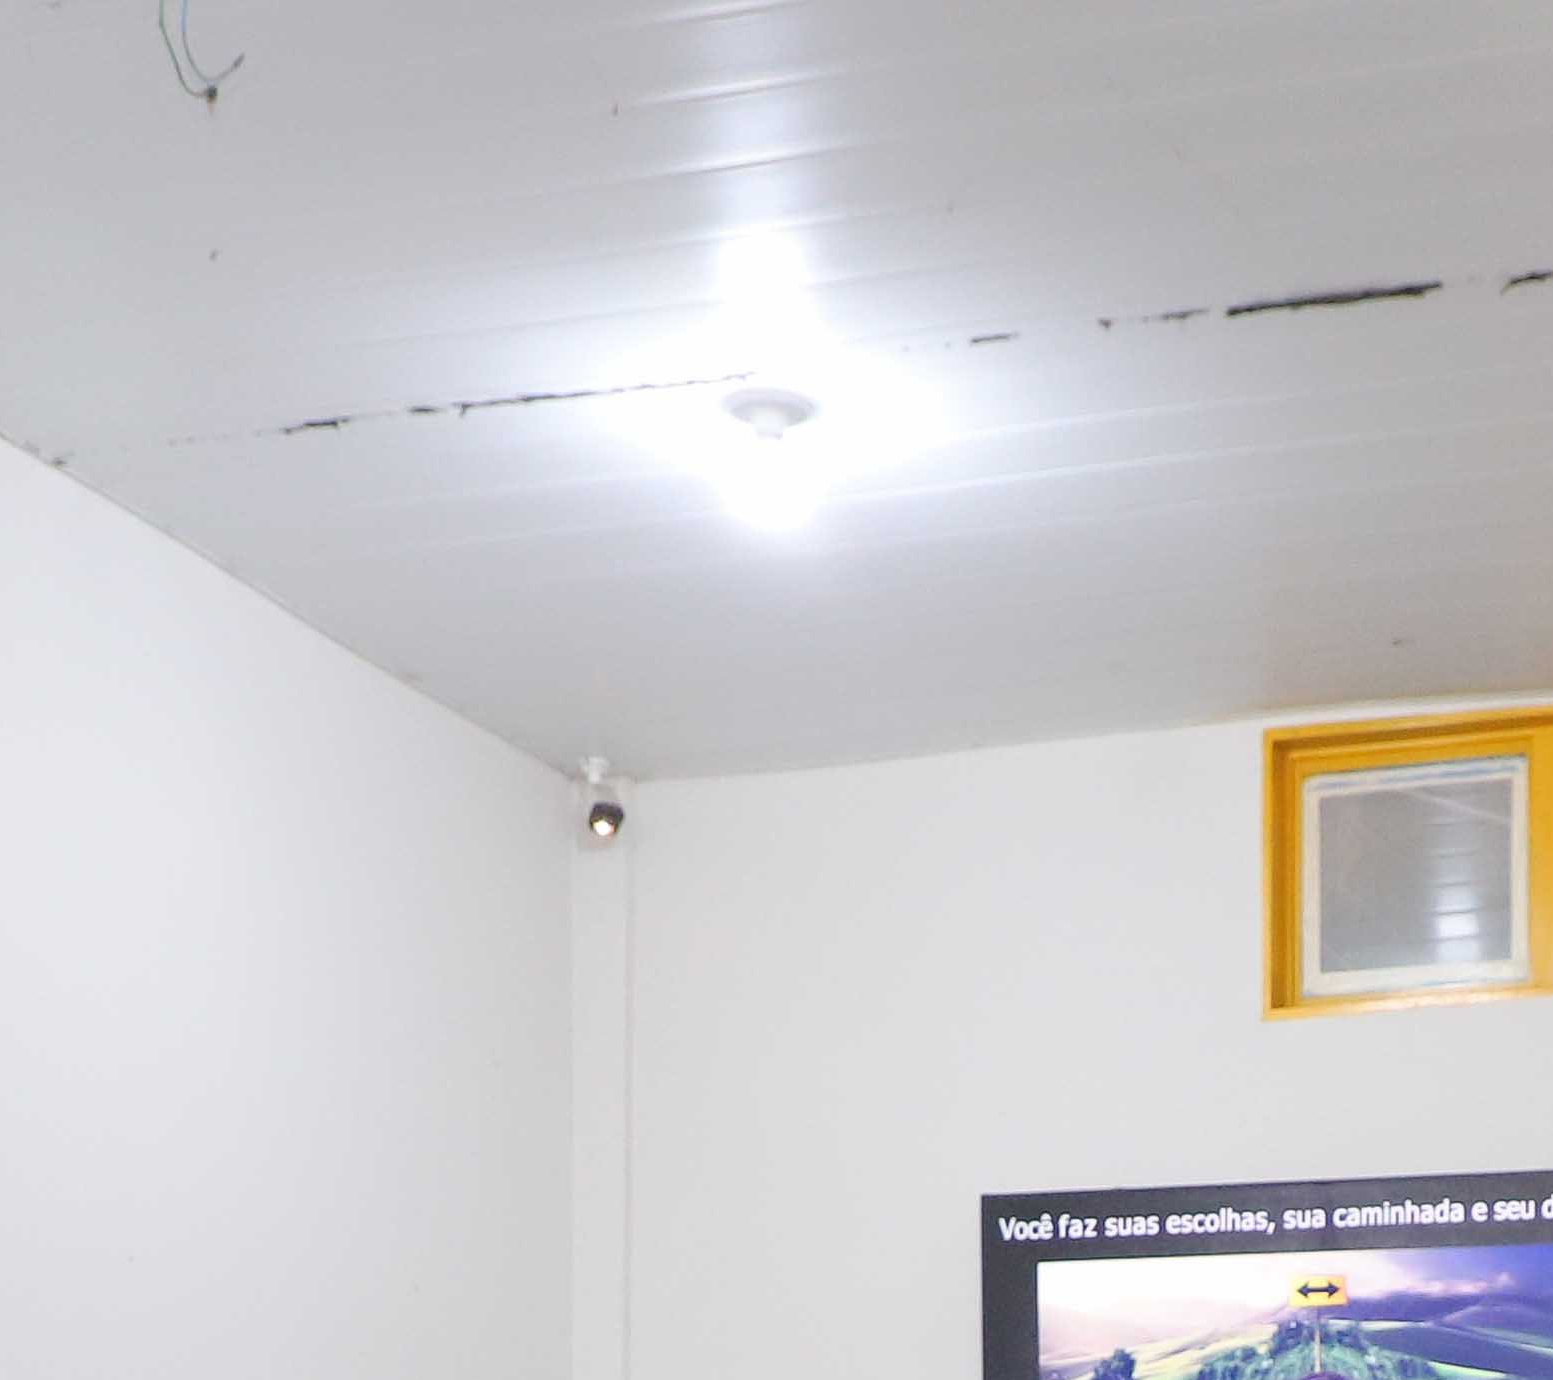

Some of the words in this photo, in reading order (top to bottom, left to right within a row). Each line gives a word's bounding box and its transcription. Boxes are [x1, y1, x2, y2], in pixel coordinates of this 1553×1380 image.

[998, 1212, 1054, 1241] Você
[1058, 1213, 1098, 1239] faz
[1103, 1214, 1161, 1238] suas
[1165, 1206, 1276, 1236] escolhas,
[1282, 1208, 1327, 1231] sua
[1332, 1198, 1465, 1229] caminhada
[1470, 1200, 1488, 1222] e
[1493, 1197, 1536, 1221] seu
